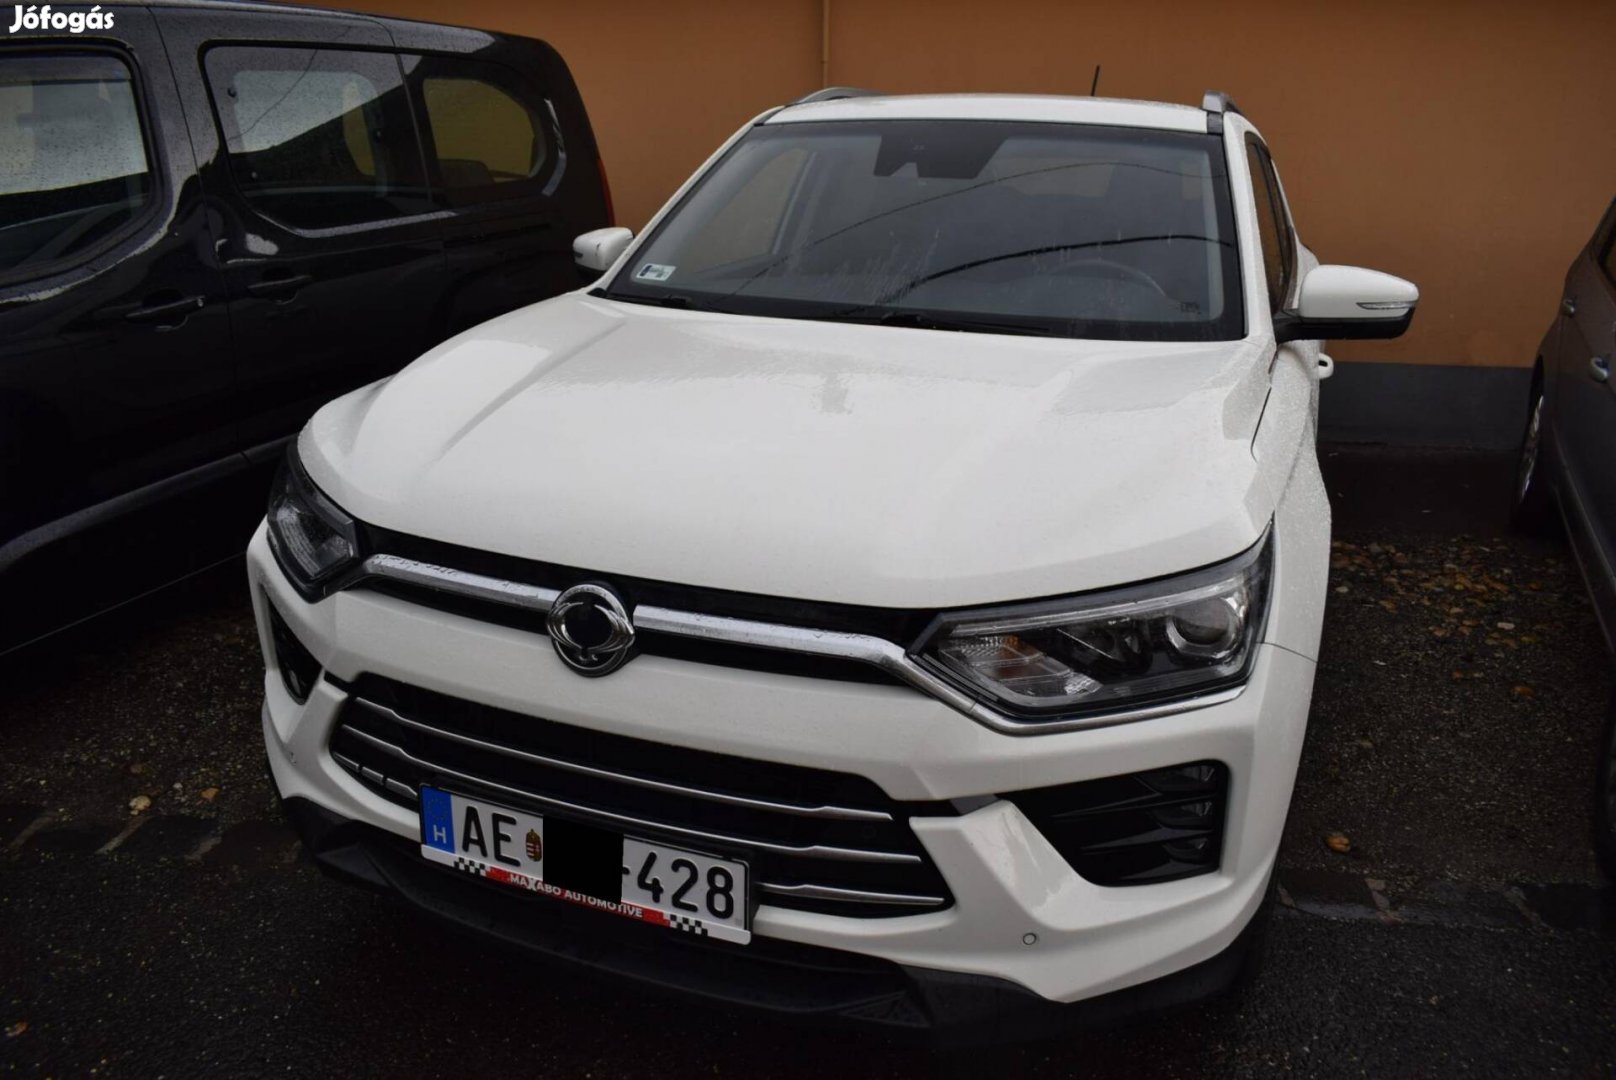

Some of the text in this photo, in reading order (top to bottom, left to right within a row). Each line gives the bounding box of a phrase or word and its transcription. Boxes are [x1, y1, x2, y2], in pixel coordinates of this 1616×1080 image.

[433, 824, 447, 844] H
[462, 806, 521, 867] AE
[510, 873, 643, 918] MAXABO AUTOMOTIVE
